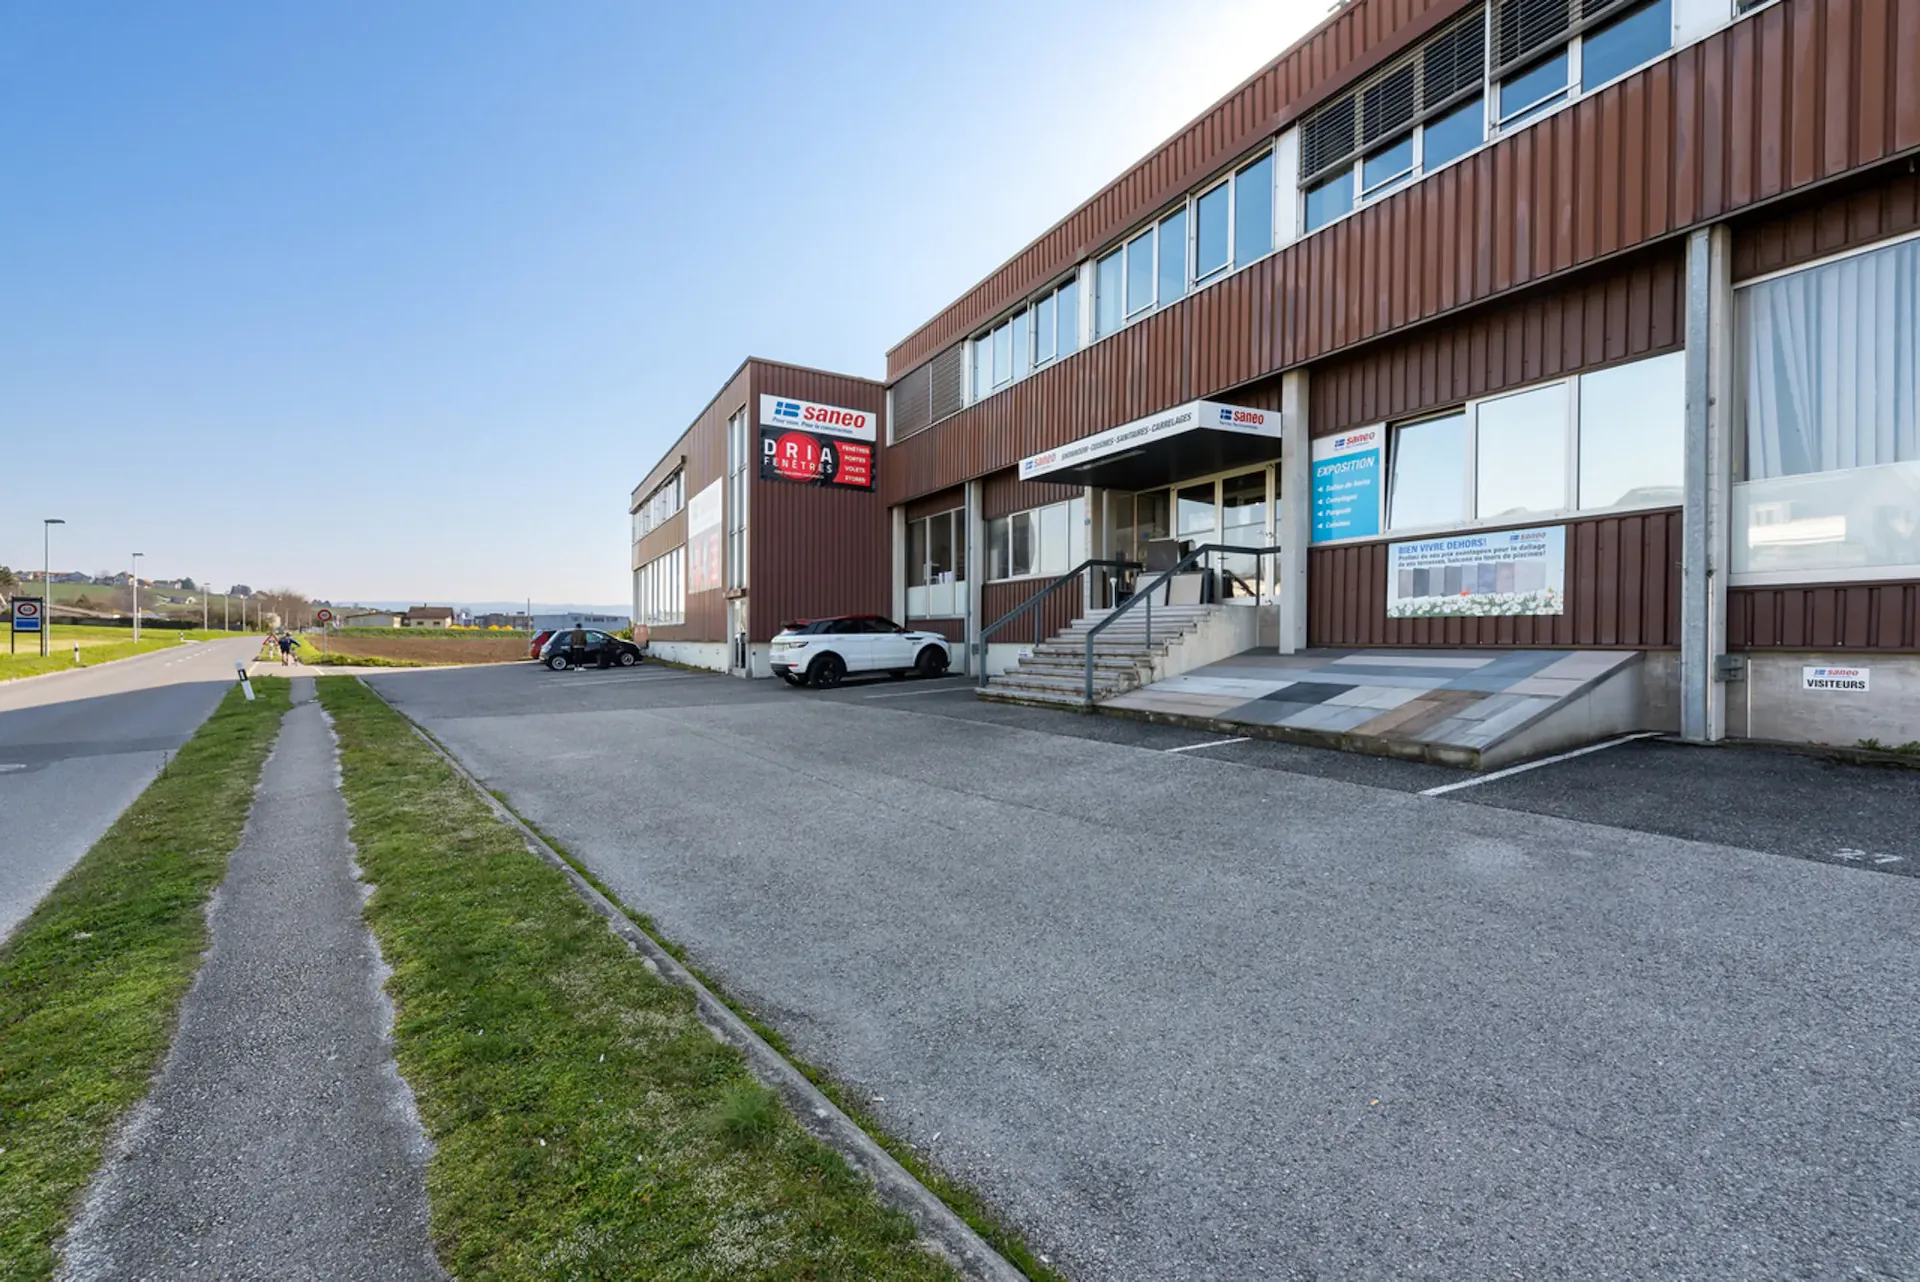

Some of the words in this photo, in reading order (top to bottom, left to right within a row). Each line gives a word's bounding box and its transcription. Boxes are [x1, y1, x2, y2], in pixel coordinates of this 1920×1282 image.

[804, 406, 865, 428] saneo
[1151, 412, 1193, 432] CARRELAGES
[1233, 410, 1265, 425] saneo
[1346, 432, 1375, 444] saneo
[764, 438, 833, 464] DRIA
[764, 456, 833, 474] FENÊTRES
[1317, 457, 1375, 477] EXPOSITION
[1420, 542, 1444, 552] VIVRE
[1807, 679, 1866, 690] VISITEURS
